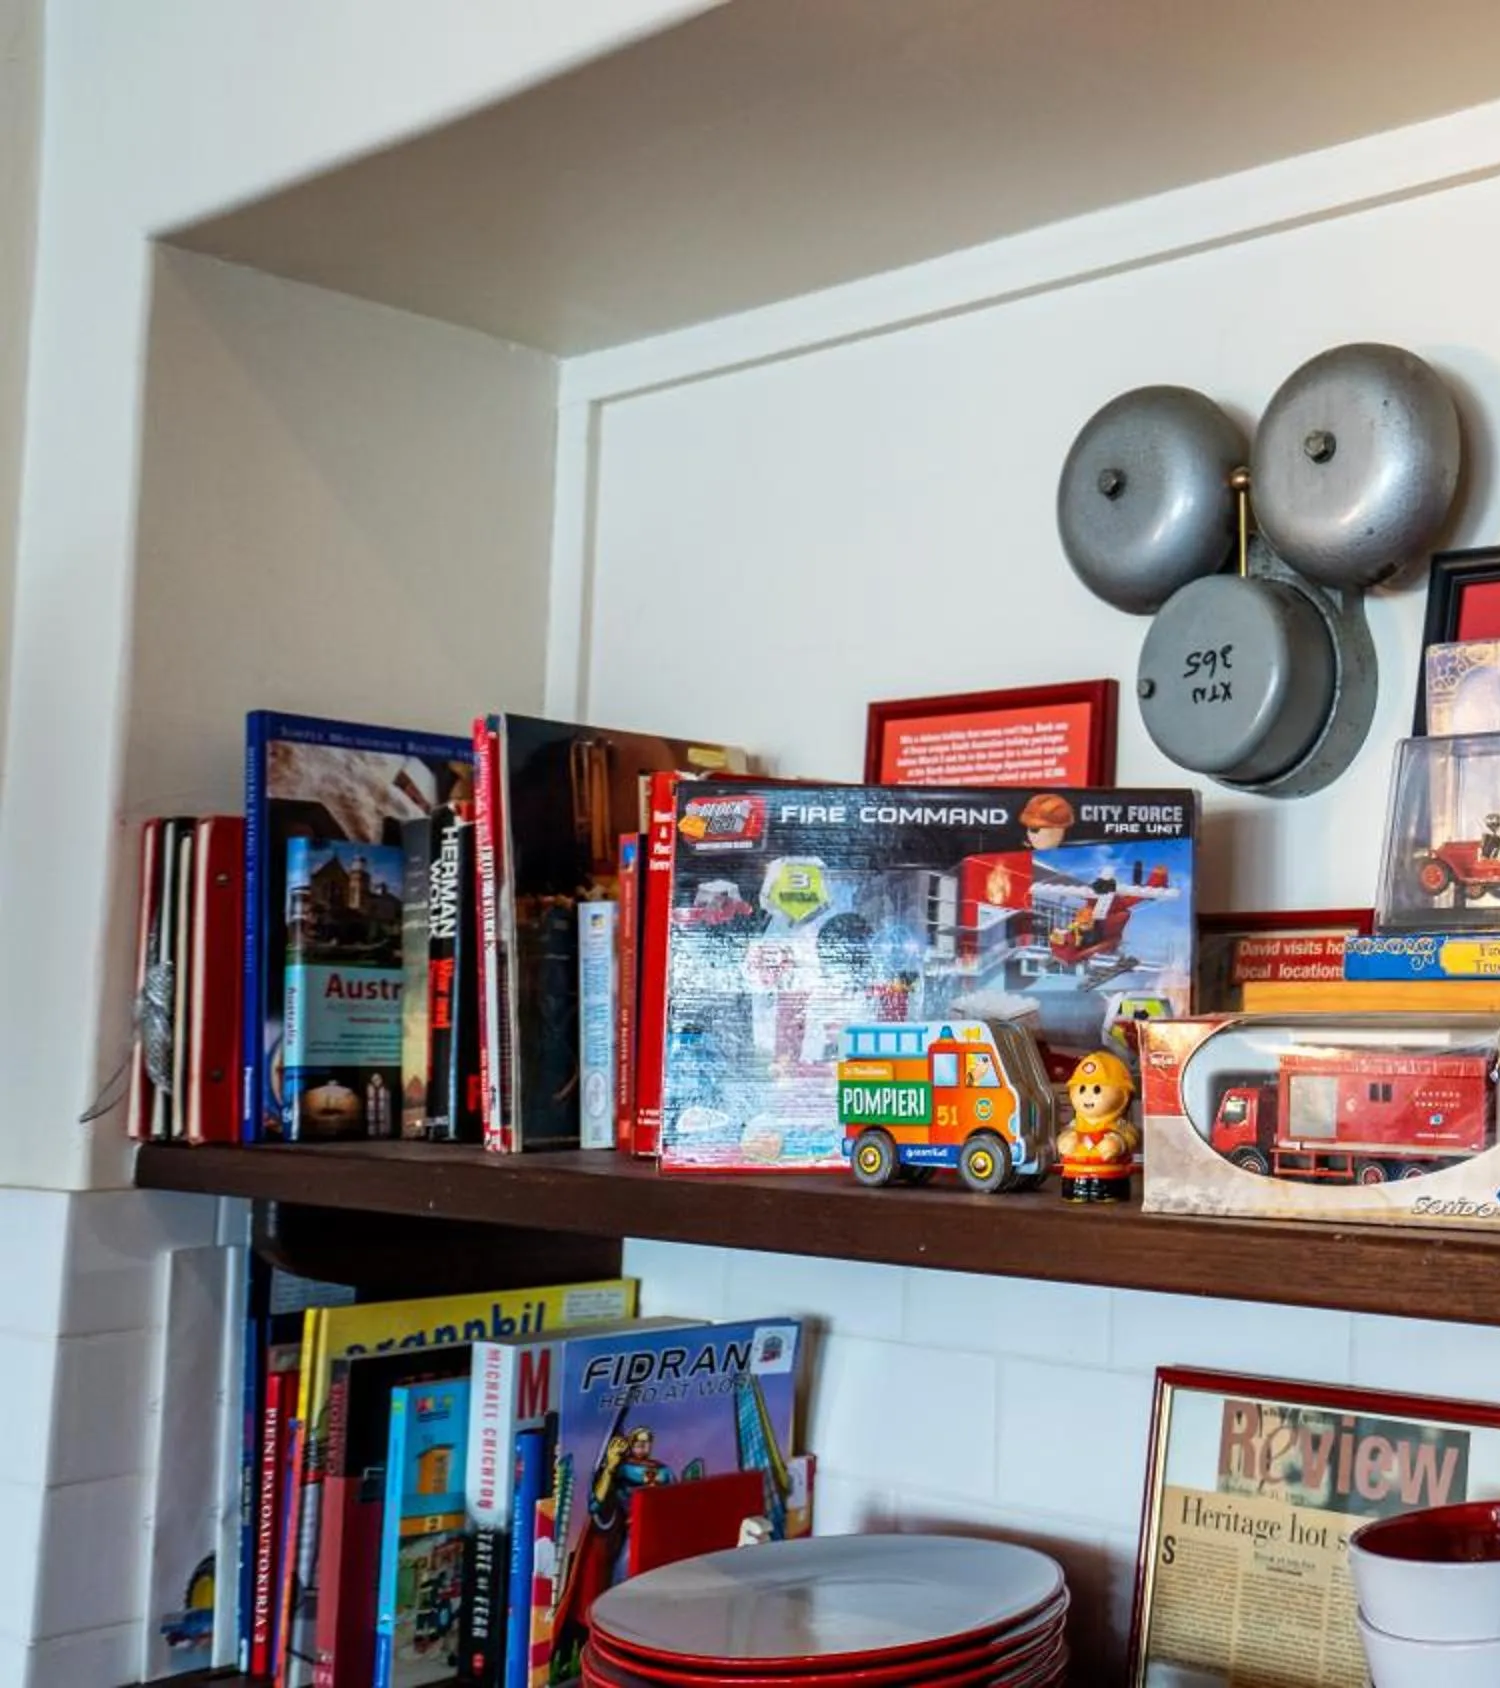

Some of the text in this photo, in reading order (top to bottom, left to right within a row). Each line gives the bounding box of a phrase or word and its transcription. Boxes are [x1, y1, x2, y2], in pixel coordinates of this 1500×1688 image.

[781, 806, 1009, 826] FIRE COMMAND
[1080, 805, 1183, 823] CITY FORCE
[1104, 824, 1183, 836] FIRE UNIT
[442, 826, 459, 938] HERMAN
[430, 859, 442, 938] WOUK
[1240, 941, 1281, 956] David
[1283, 940, 1324, 955] visits
[1235, 964, 1272, 979] local
[842, 1087, 925, 1117] POMPIERI
[937, 1105, 959, 1127] 51
[483, 1347, 503, 1418] MICHAEL
[1218, 1399, 1459, 1507] Review
[1181, 1495, 1329, 1549] Heritage hot
[470, 1596, 491, 1639] FEAR
